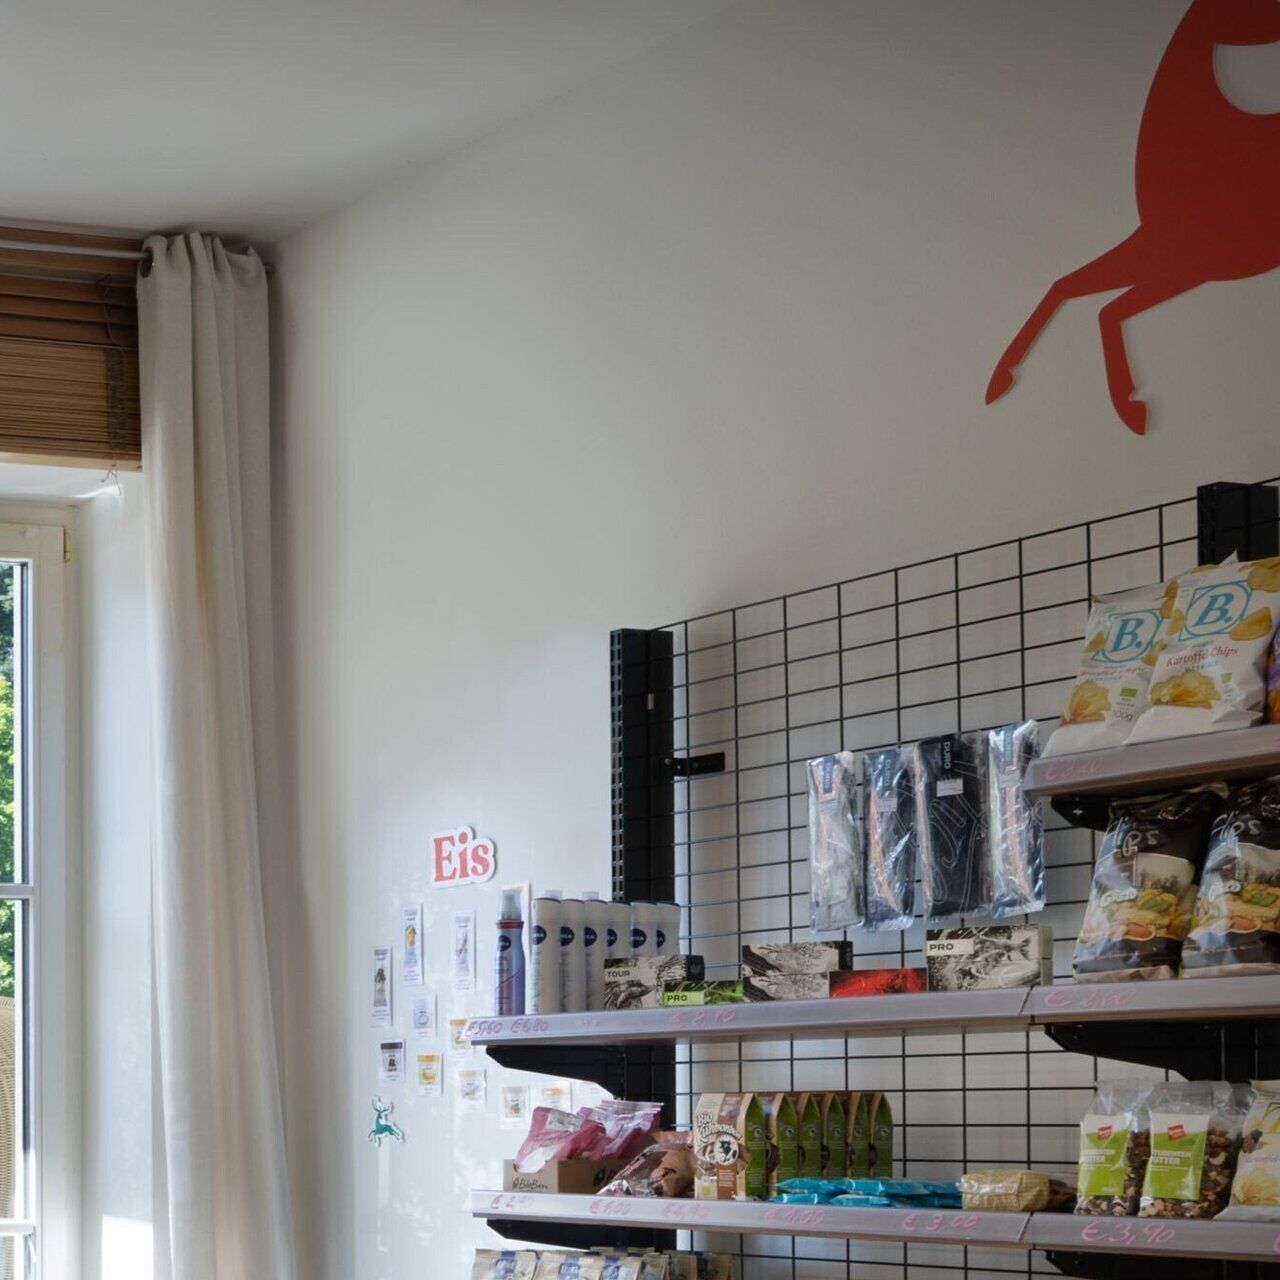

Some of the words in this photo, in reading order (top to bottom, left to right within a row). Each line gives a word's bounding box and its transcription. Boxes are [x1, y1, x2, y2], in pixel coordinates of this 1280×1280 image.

[1209, 646, 1240, 657] Chips
[434, 831, 489, 883] Eis
[929, 942, 954, 951] PRO
[607, 970, 630, 978] TOUR
[667, 994, 688, 1002] PRO
[697, 1112, 713, 1126] Bio
[903, 1212, 920, 1231] €
[1081, 1220, 1108, 1242] €
[1108, 1221, 1176, 1245] 3,90
